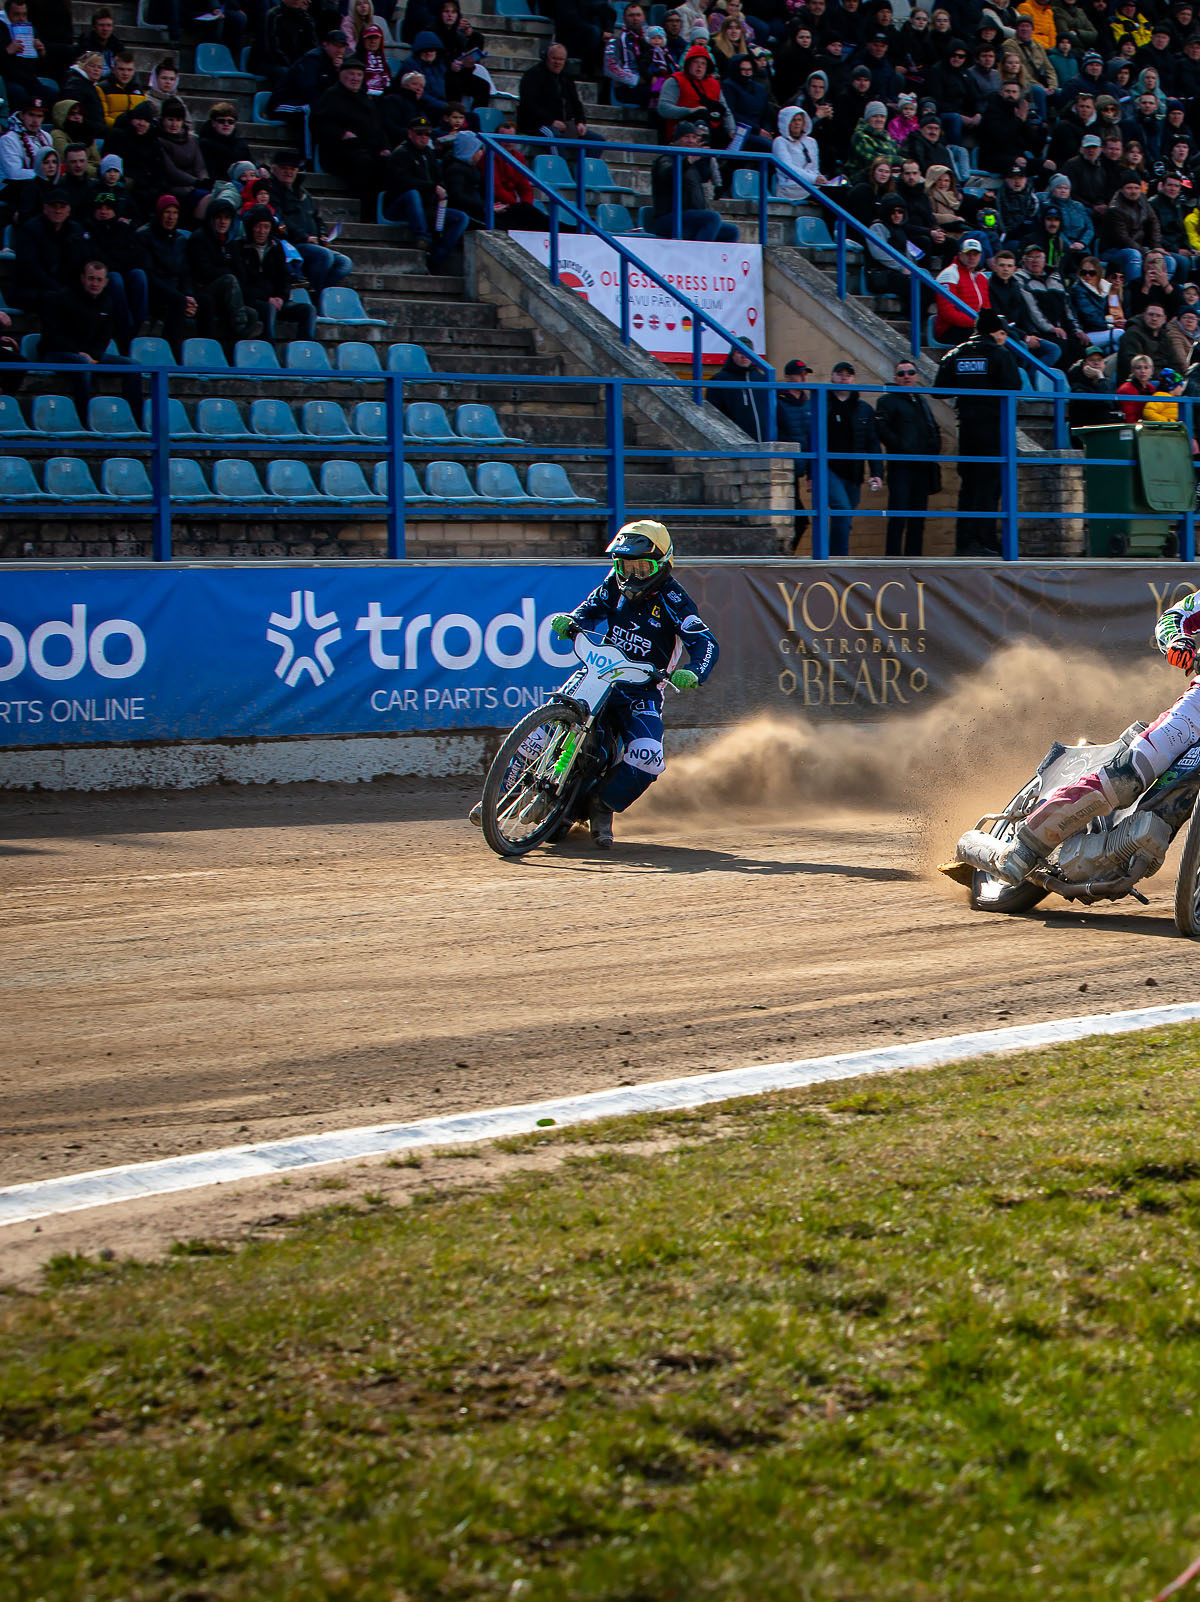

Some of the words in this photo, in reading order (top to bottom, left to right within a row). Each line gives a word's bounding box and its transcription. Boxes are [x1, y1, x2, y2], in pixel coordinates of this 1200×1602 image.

[713, 276, 736, 292] LTD
[777, 581, 927, 632] YOGGI
[778, 635, 927, 654] GASTROBĀRS
[801, 658, 909, 706] BEAR
[50, 697, 145, 723] ONLINE
[371, 689, 418, 712] CAR
[424, 687, 498, 709] PARTS
